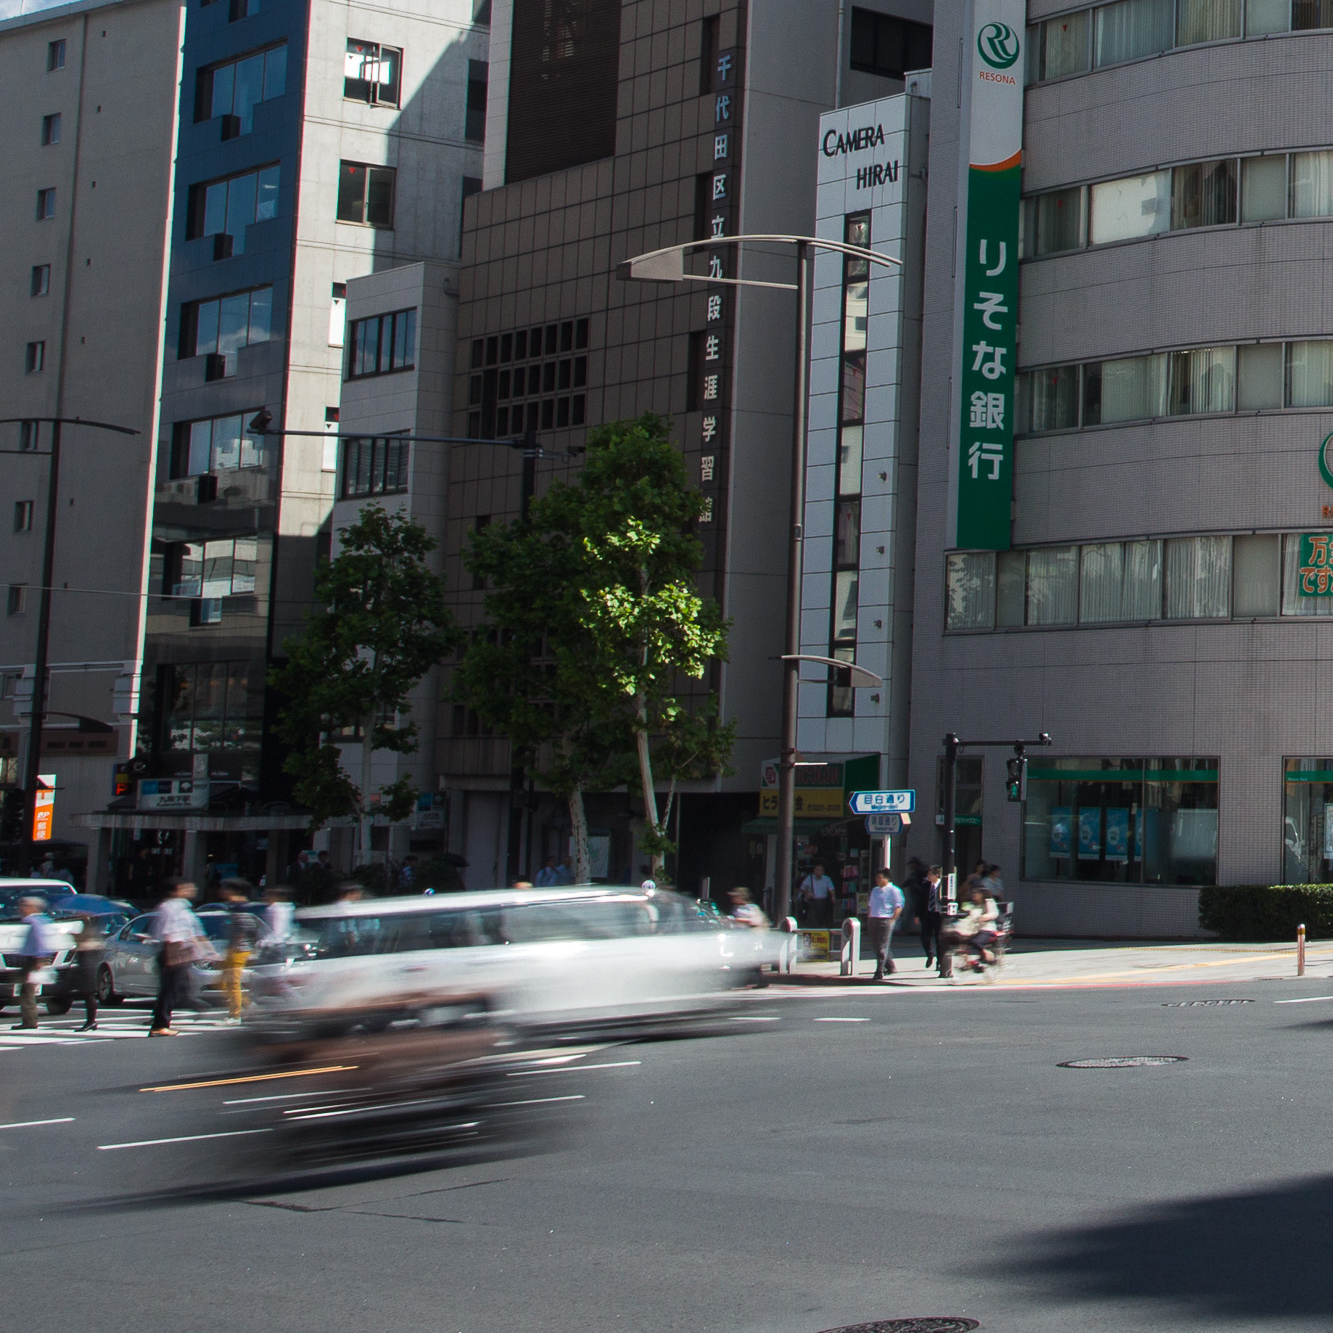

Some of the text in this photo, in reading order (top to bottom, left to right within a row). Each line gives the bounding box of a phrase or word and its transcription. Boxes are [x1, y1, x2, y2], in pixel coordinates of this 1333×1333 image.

[979, 70, 1017, 86] RESONA
[823, 123, 885, 157] CAMERA
[857, 160, 899, 190] HIRAI
[968, 238, 1007, 481] りそな銀行
[763, 795, 804, 811] ヒラ会
[864, 794, 905, 805] 目白通り
